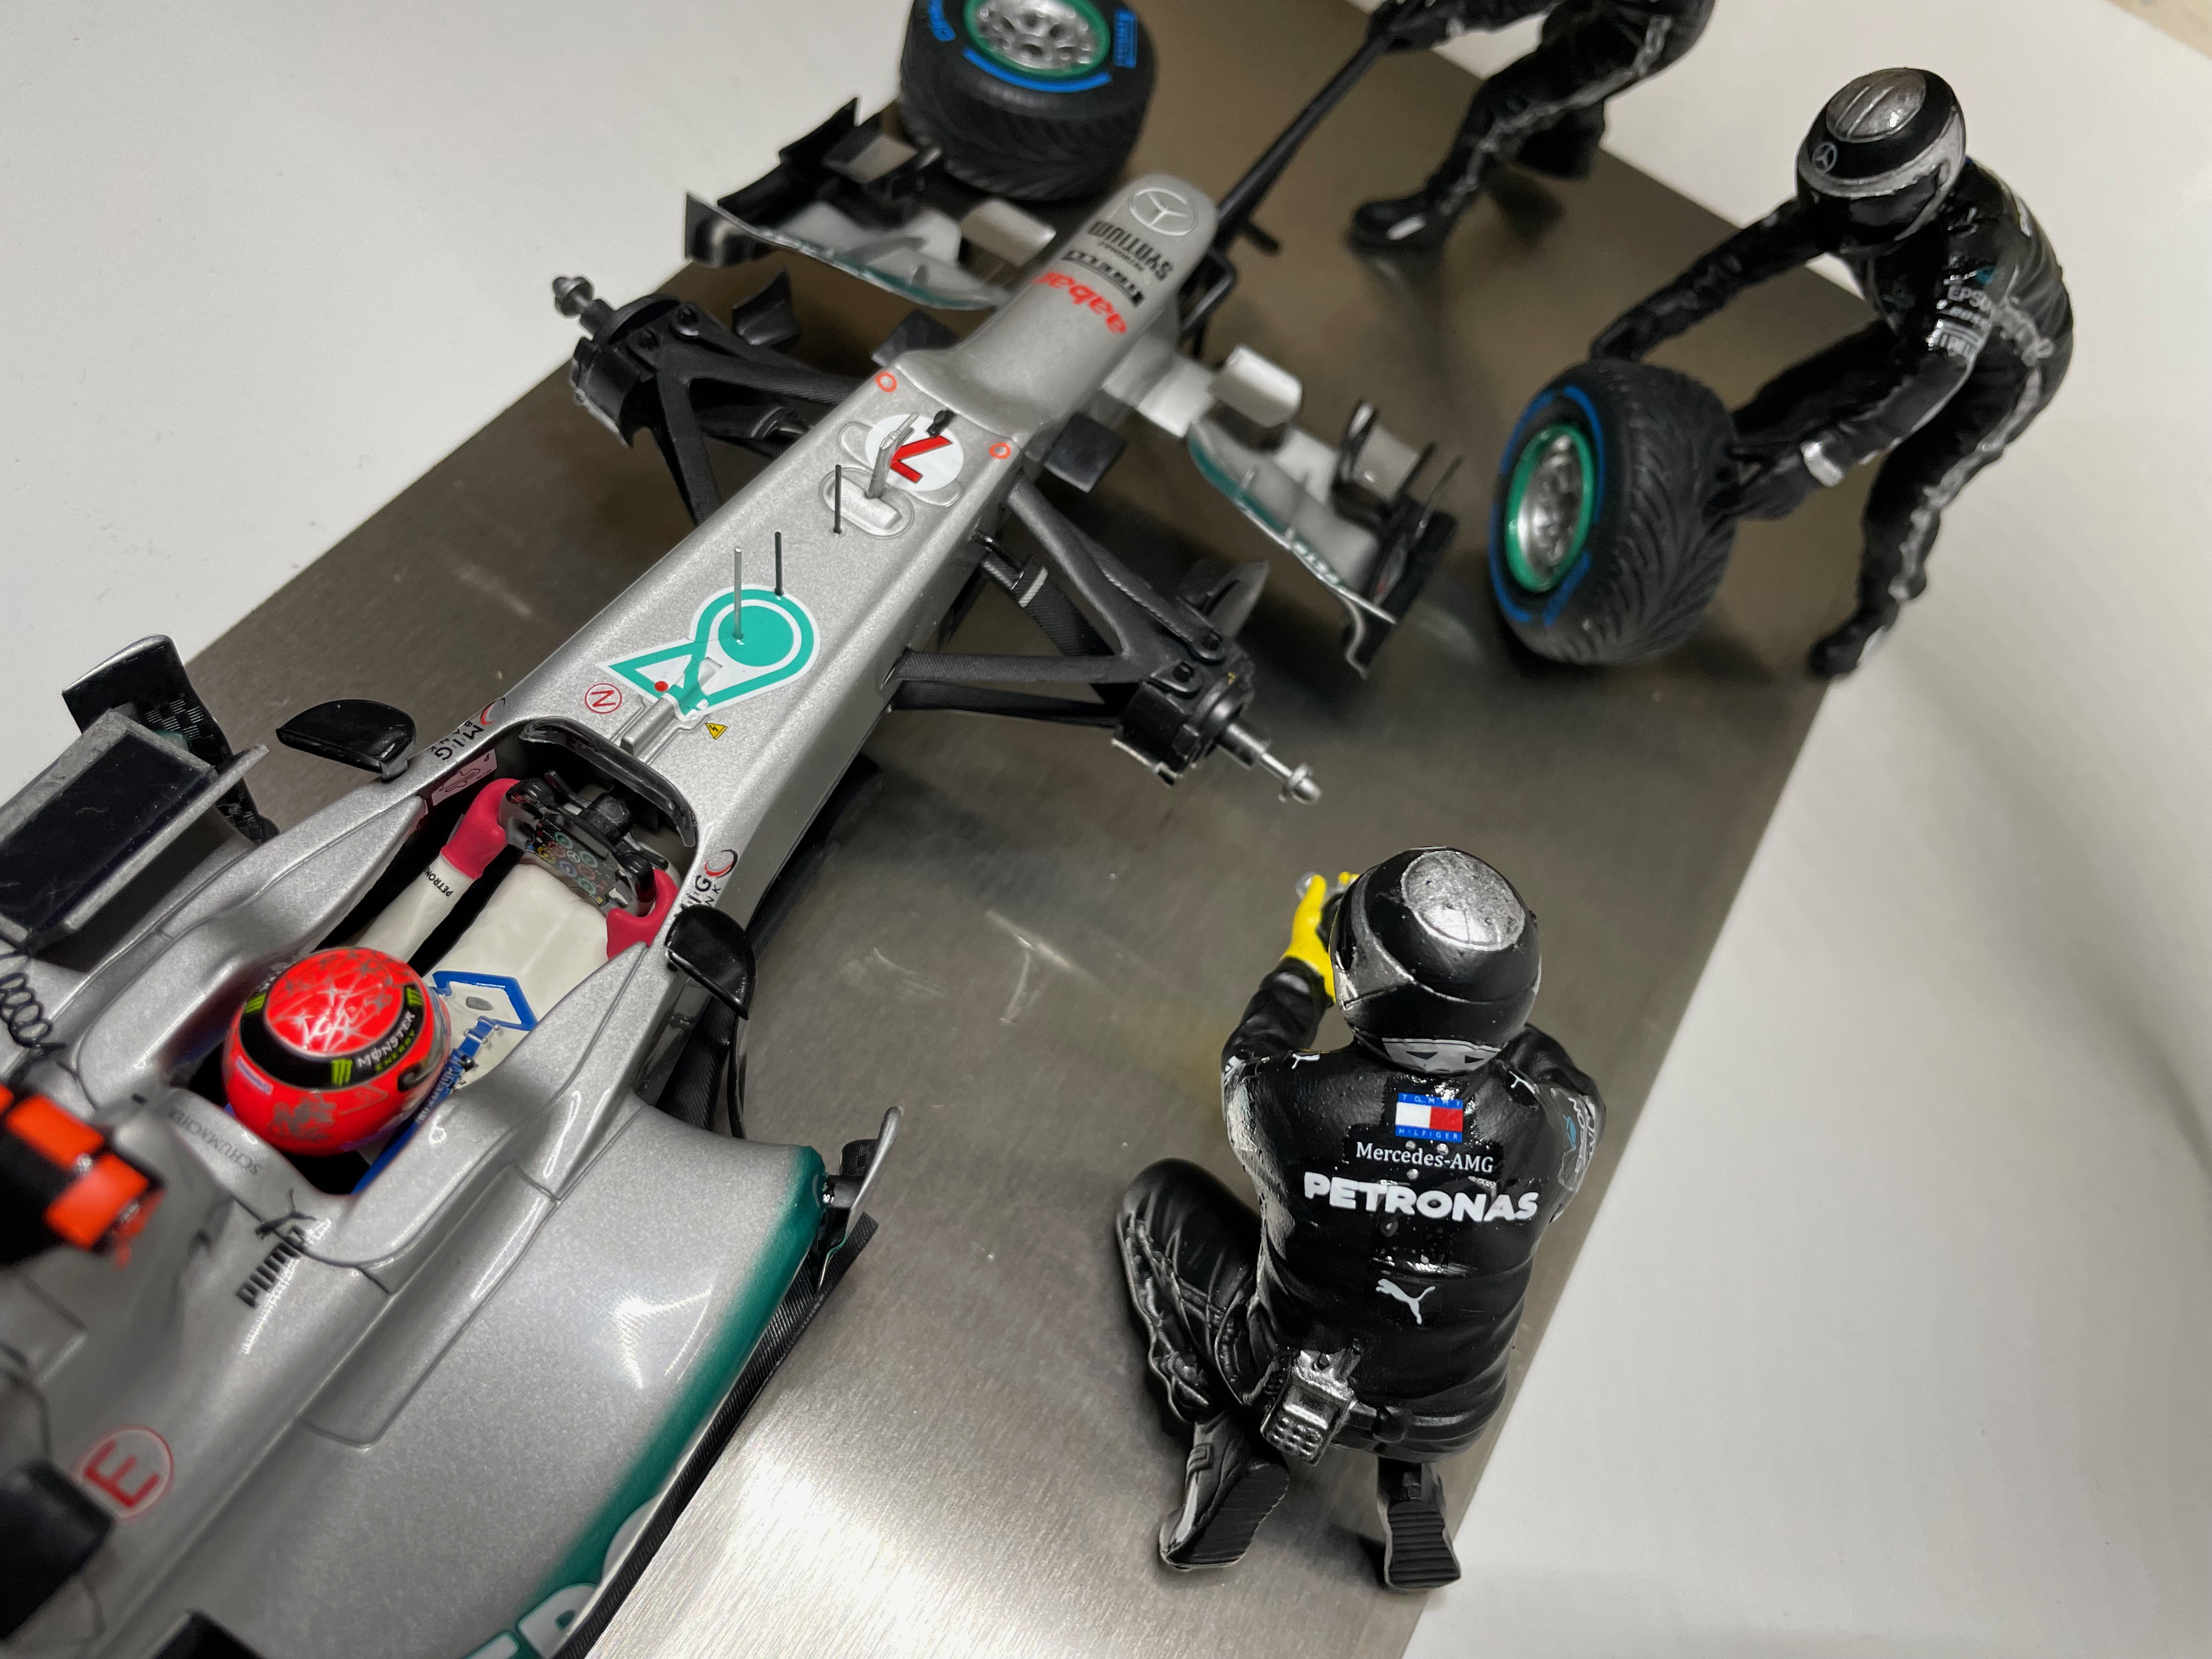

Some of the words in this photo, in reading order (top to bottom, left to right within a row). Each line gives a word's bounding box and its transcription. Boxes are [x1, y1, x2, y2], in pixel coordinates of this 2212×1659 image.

[1088, 221, 1173, 281] SYNTIUM
[1061, 250, 1145, 308] PIRELLI
[425, 868, 453, 898] PETRON
[357, 1011, 416, 1068] MONSTER
[375, 1030, 415, 1072] ENERGY
[1402, 1093, 1463, 1108] TOMMY
[1356, 1141, 1494, 1173] Mercedes-AMG
[1398, 1127, 1460, 1141] HILFIGER
[1304, 1171, 1538, 1223] PETRONAS
[84, 1439, 160, 1508] E
